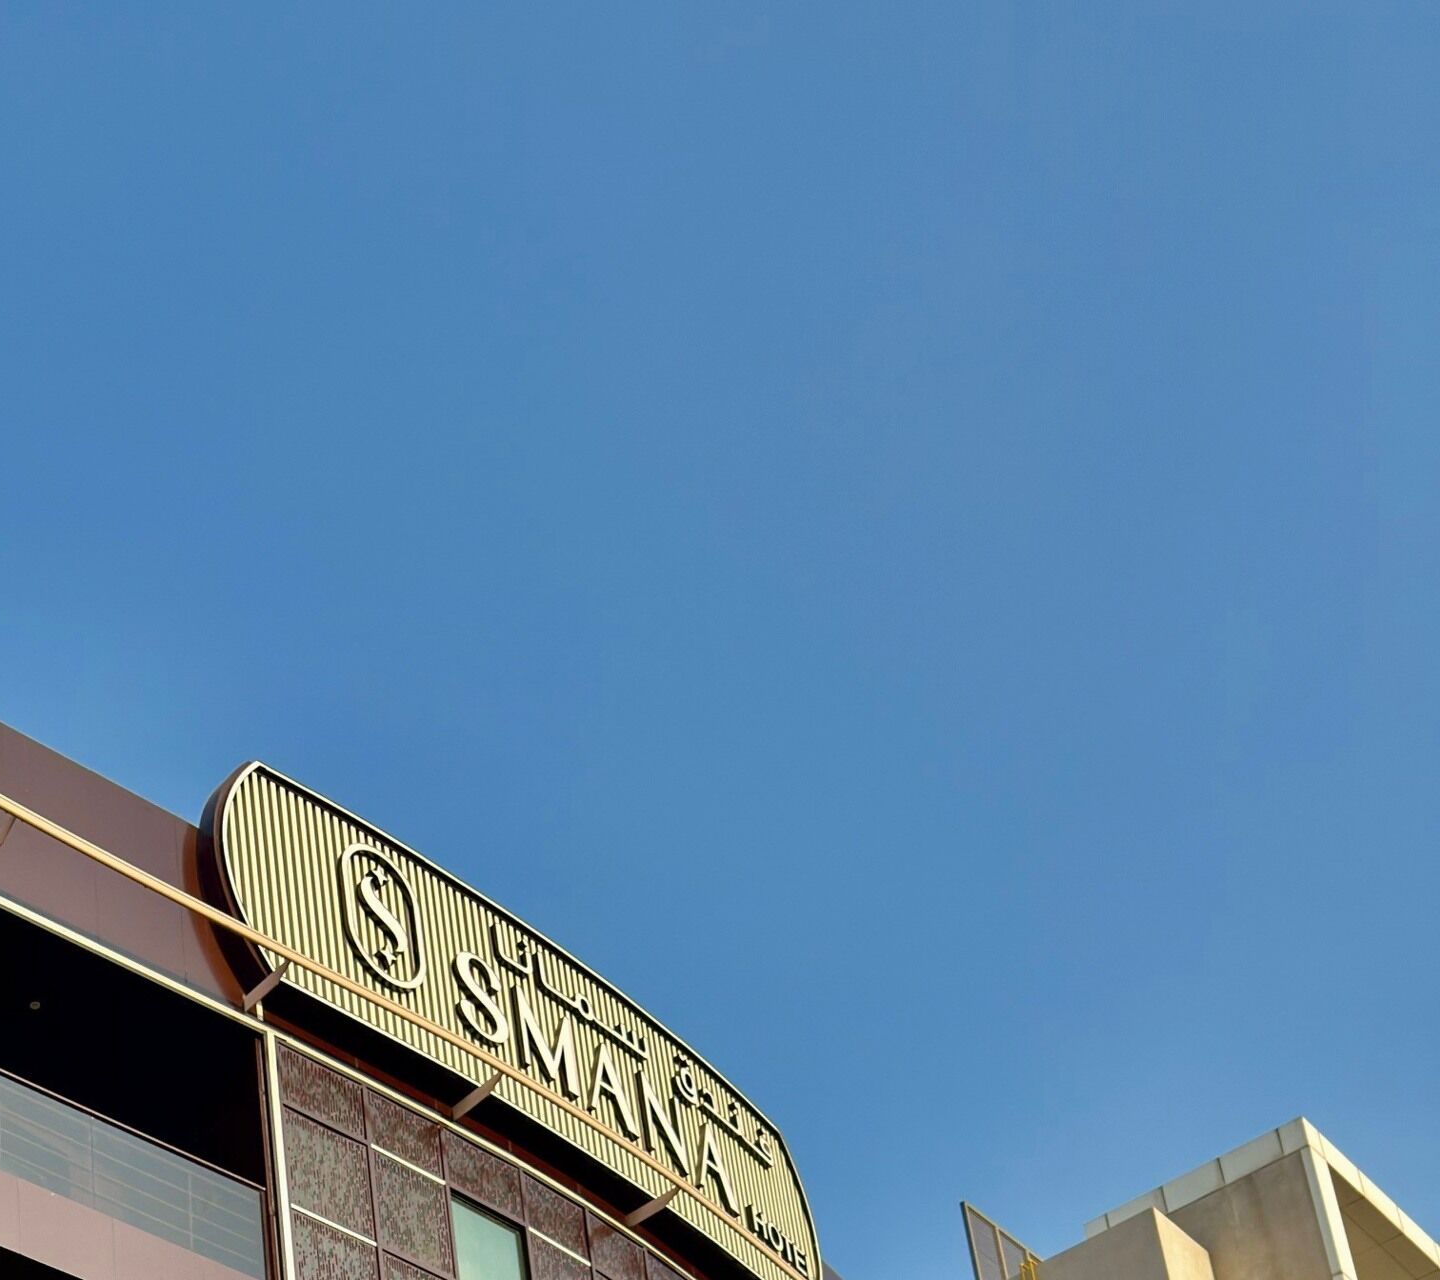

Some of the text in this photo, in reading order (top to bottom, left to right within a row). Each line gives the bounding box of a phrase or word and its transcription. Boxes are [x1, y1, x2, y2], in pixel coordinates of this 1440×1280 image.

[455, 951, 740, 1217] SMANA
[494, 922, 774, 1167] فندق سمانا
